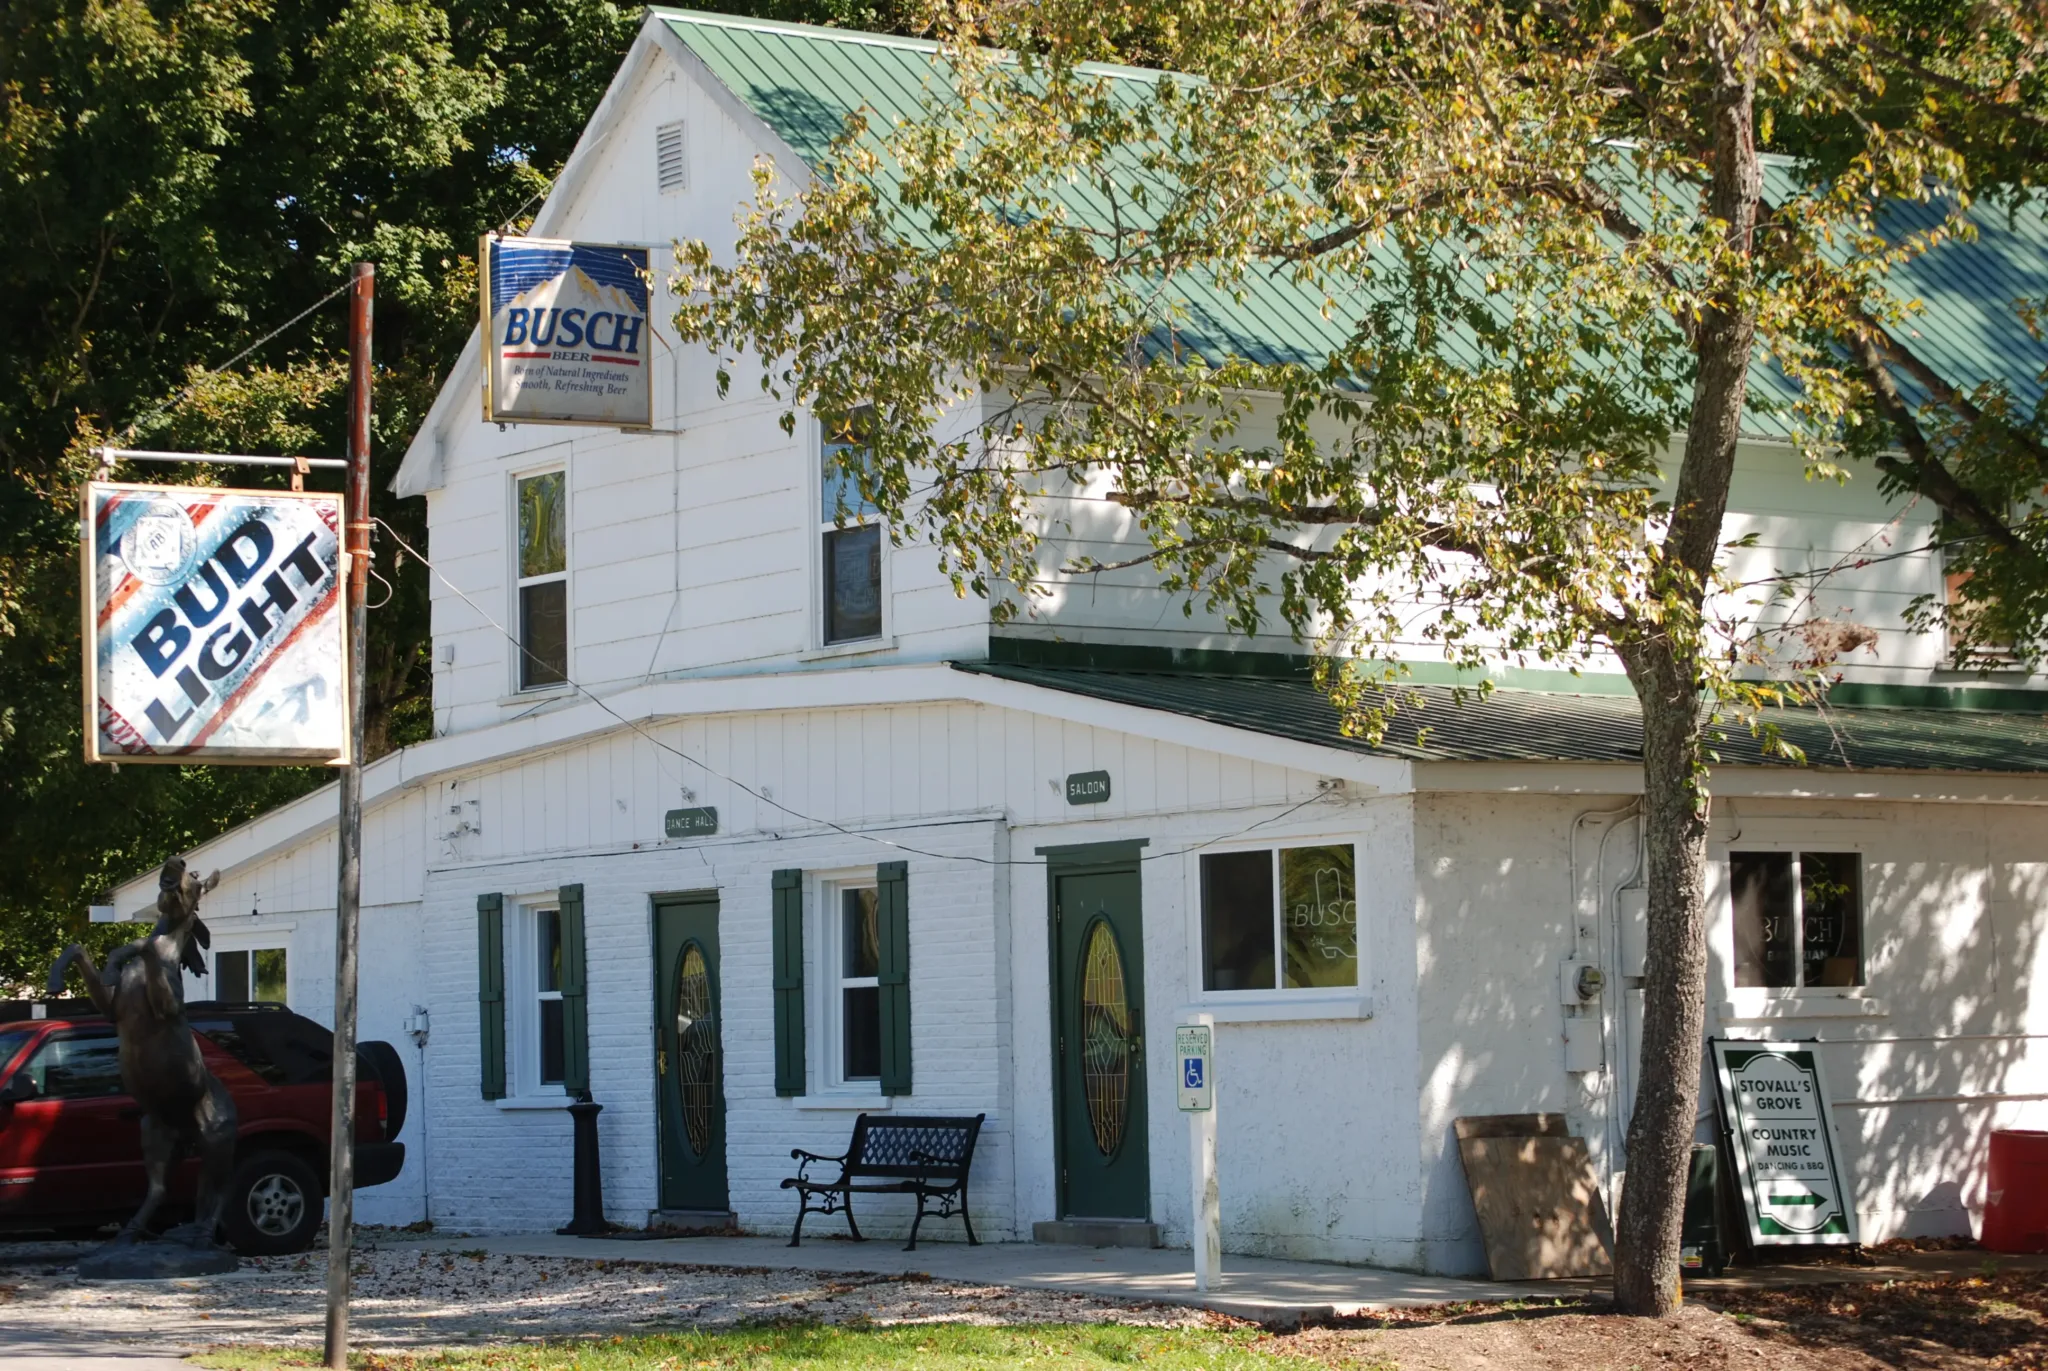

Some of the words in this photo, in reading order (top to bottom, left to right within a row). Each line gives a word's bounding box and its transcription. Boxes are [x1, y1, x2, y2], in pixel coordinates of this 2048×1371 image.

[502, 307, 644, 354] BUSCH
[552, 351, 590, 362] BEER
[514, 365, 534, 375] Born
[535, 366, 545, 378] of
[545, 366, 580, 378] Natural
[582, 369, 629, 384] Ingredients
[554, 381, 604, 397] Refreshing
[607, 383, 627, 395] Beer
[130, 519, 275, 679] BUD
[143, 531, 325, 743] LIGHT
[1070, 781, 1106, 796] SALOON
[666, 817, 690, 830] DANCE
[695, 815, 714, 827] HALL
[1294, 900, 1357, 927] BUSC
[1760, 916, 1834, 942] BUCH
[1177, 1033, 1208, 1045] RESERVED
[1179, 1045, 1207, 1056] PARKING
[1740, 1080, 1811, 1093] STOVALL'S
[1756, 1097, 1802, 1110] GROVE
[1752, 1128, 1817, 1140] COUNTRY
[1767, 1144, 1811, 1157] MUSIC
[1757, 1161, 1798, 1170] DANCING
[1806, 1161, 1824, 1170] BBQ
